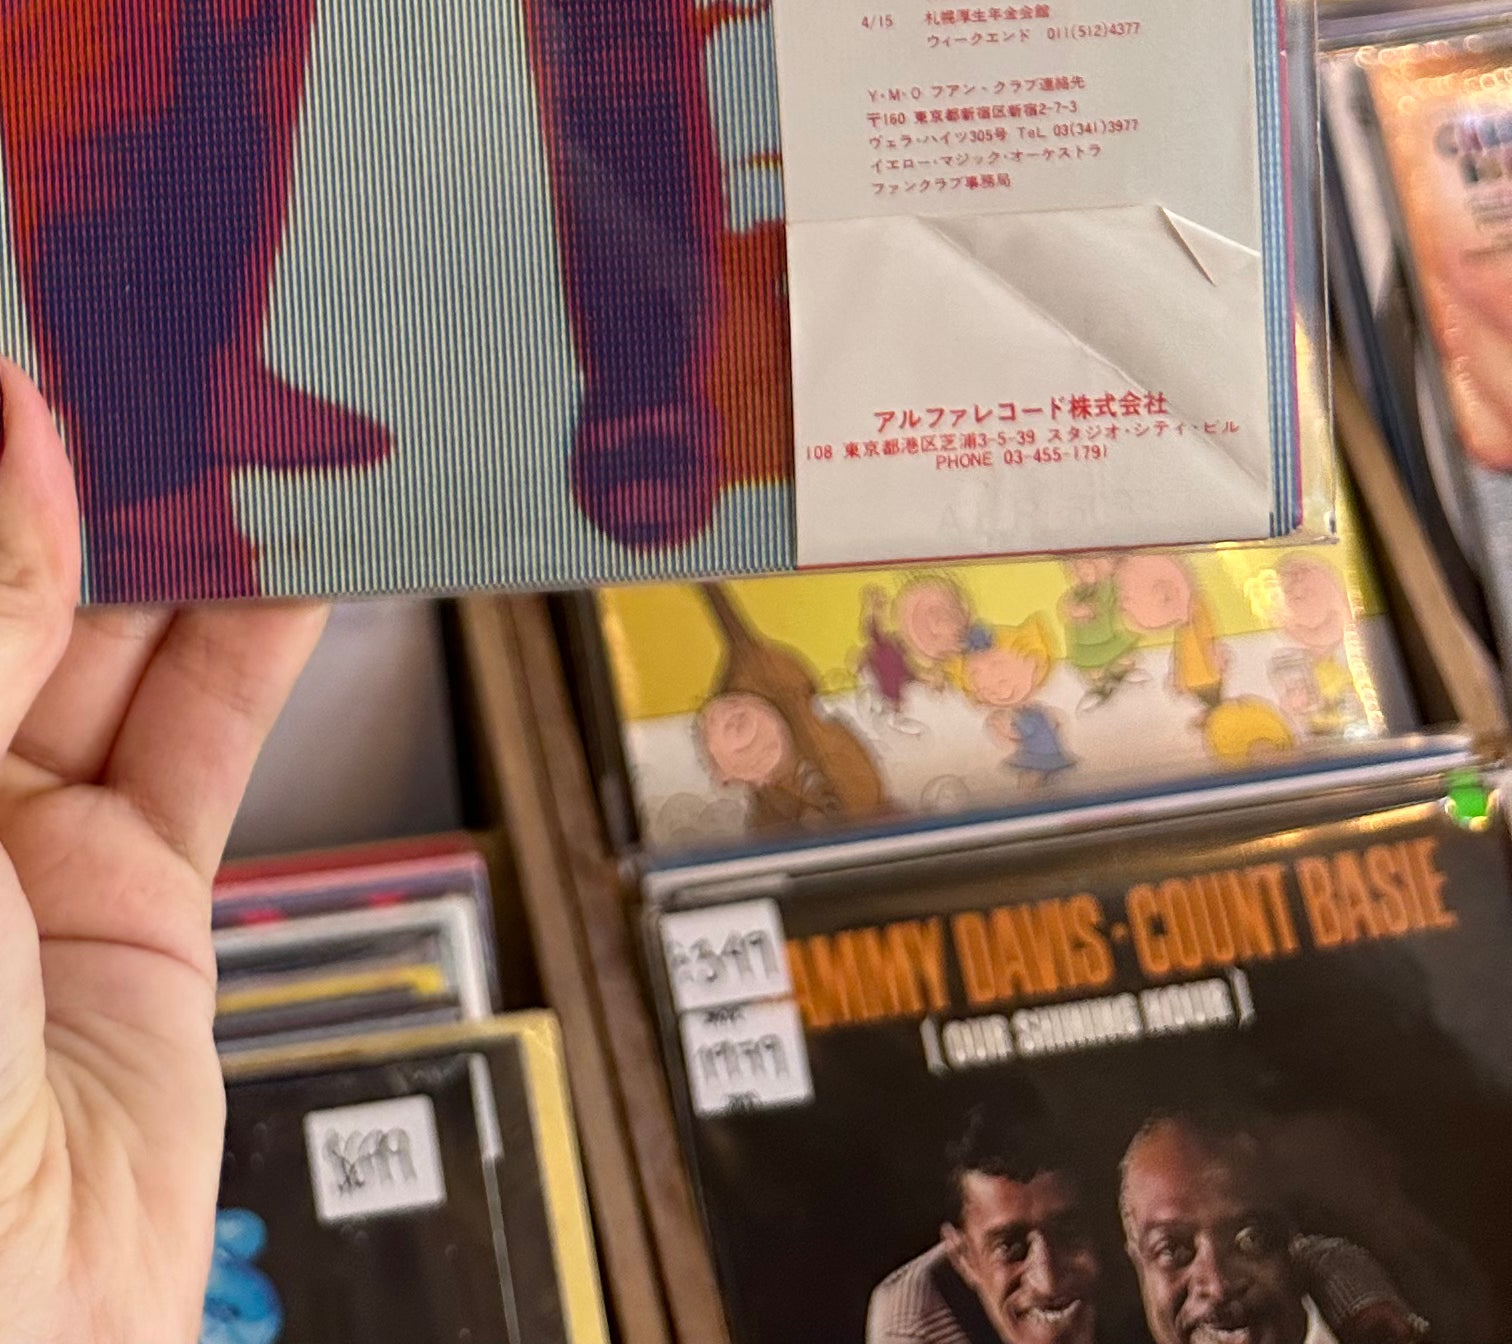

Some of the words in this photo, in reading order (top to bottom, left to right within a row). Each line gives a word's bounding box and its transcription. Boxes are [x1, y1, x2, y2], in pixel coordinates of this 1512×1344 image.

[861, 15, 894, 29] 4/15
[874, 390, 1168, 433] アルファレコード株式会社
[806, 444, 834, 461] 108
[843, 429, 1036, 460] 東京都港区芝浦3-5-39
[936, 451, 993, 470] PHONE
[1004, 445, 1110, 466] 03-455-1791
[787, 916, 952, 1030] AMMY
[1125, 863, 1298, 982] COUNT
[1295, 836, 1459, 949] BASIE
